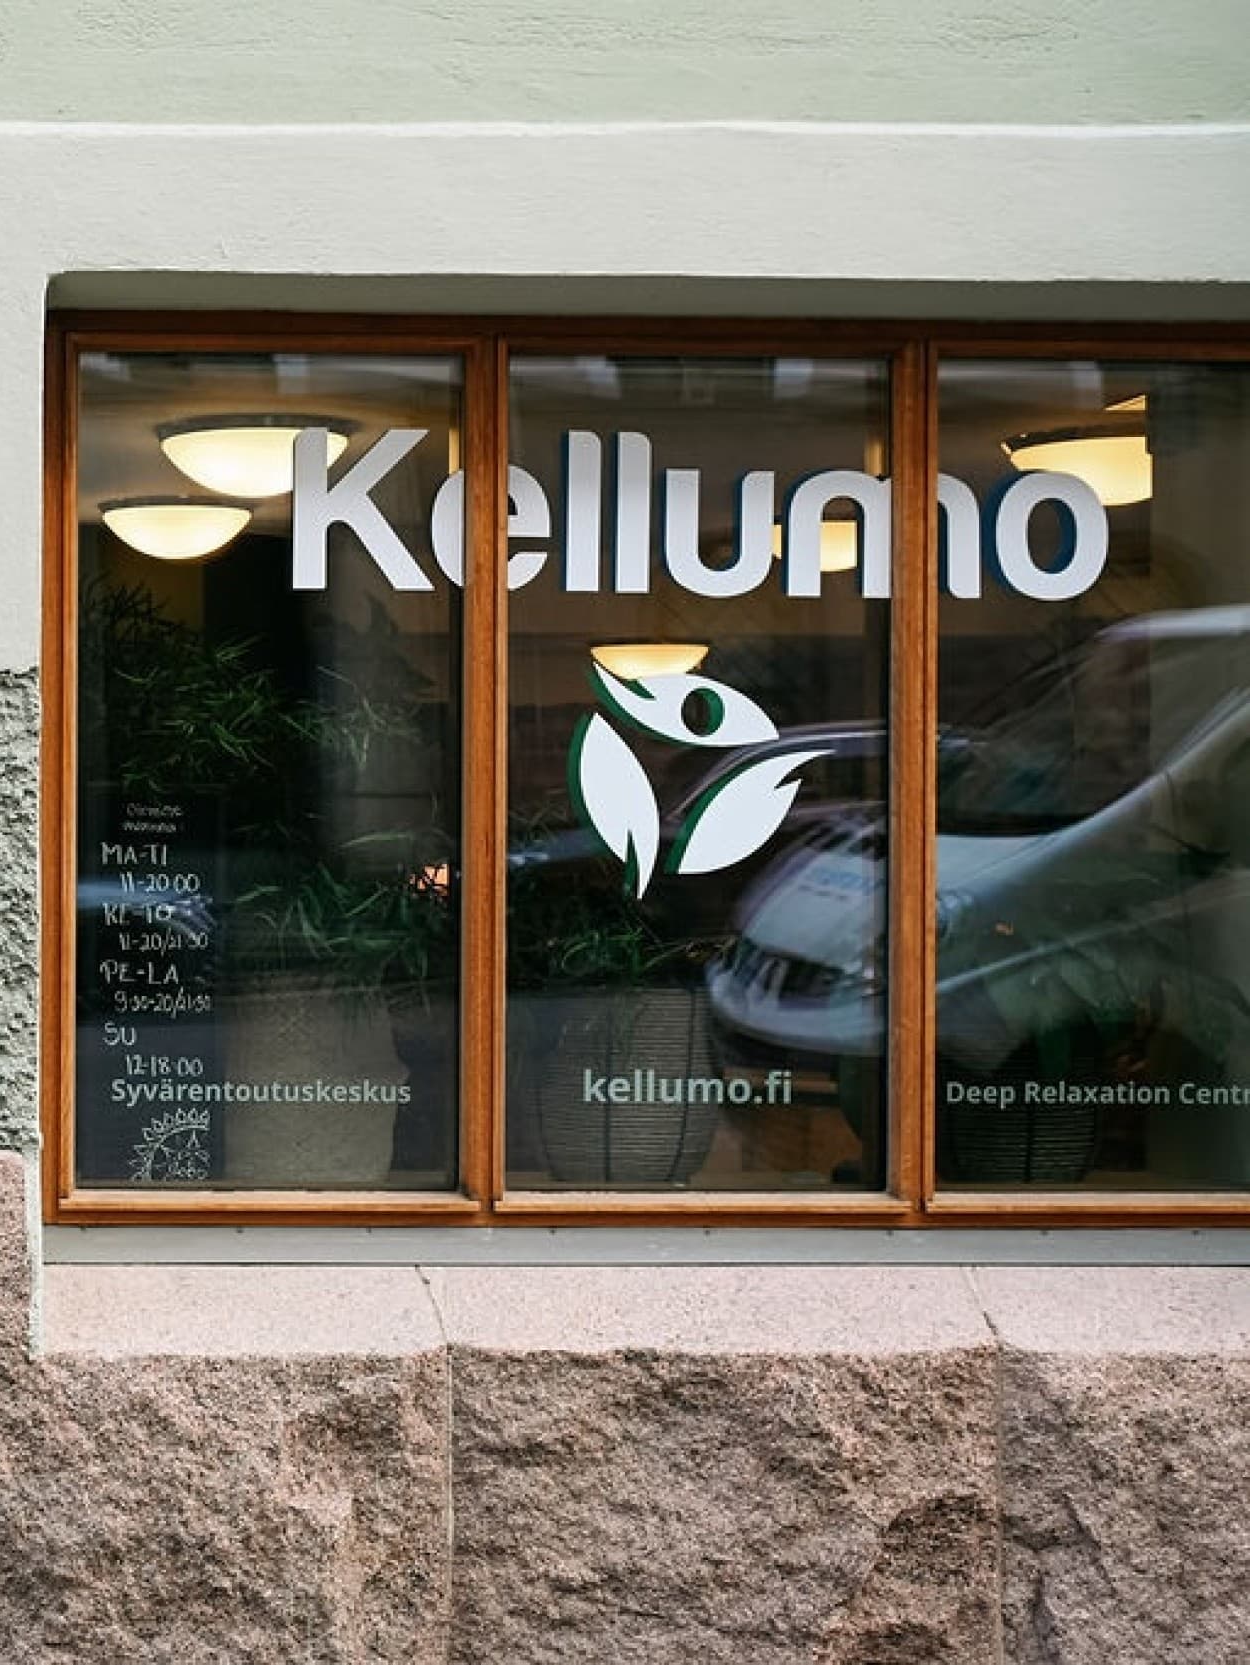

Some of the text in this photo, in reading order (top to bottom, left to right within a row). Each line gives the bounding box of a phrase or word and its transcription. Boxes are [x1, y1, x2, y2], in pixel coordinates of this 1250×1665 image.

[291, 428, 1110, 600] Kellumo
[101, 841, 167, 867] MA-TI
[99, 960, 179, 985] PE-LA
[111, 1077, 412, 1107] Syvärentoutuskeskus
[583, 1068, 793, 1105] kellumo.fi
[946, 1080, 1016, 1110] Deep
[1024, 1080, 1171, 1105] Relaxation
